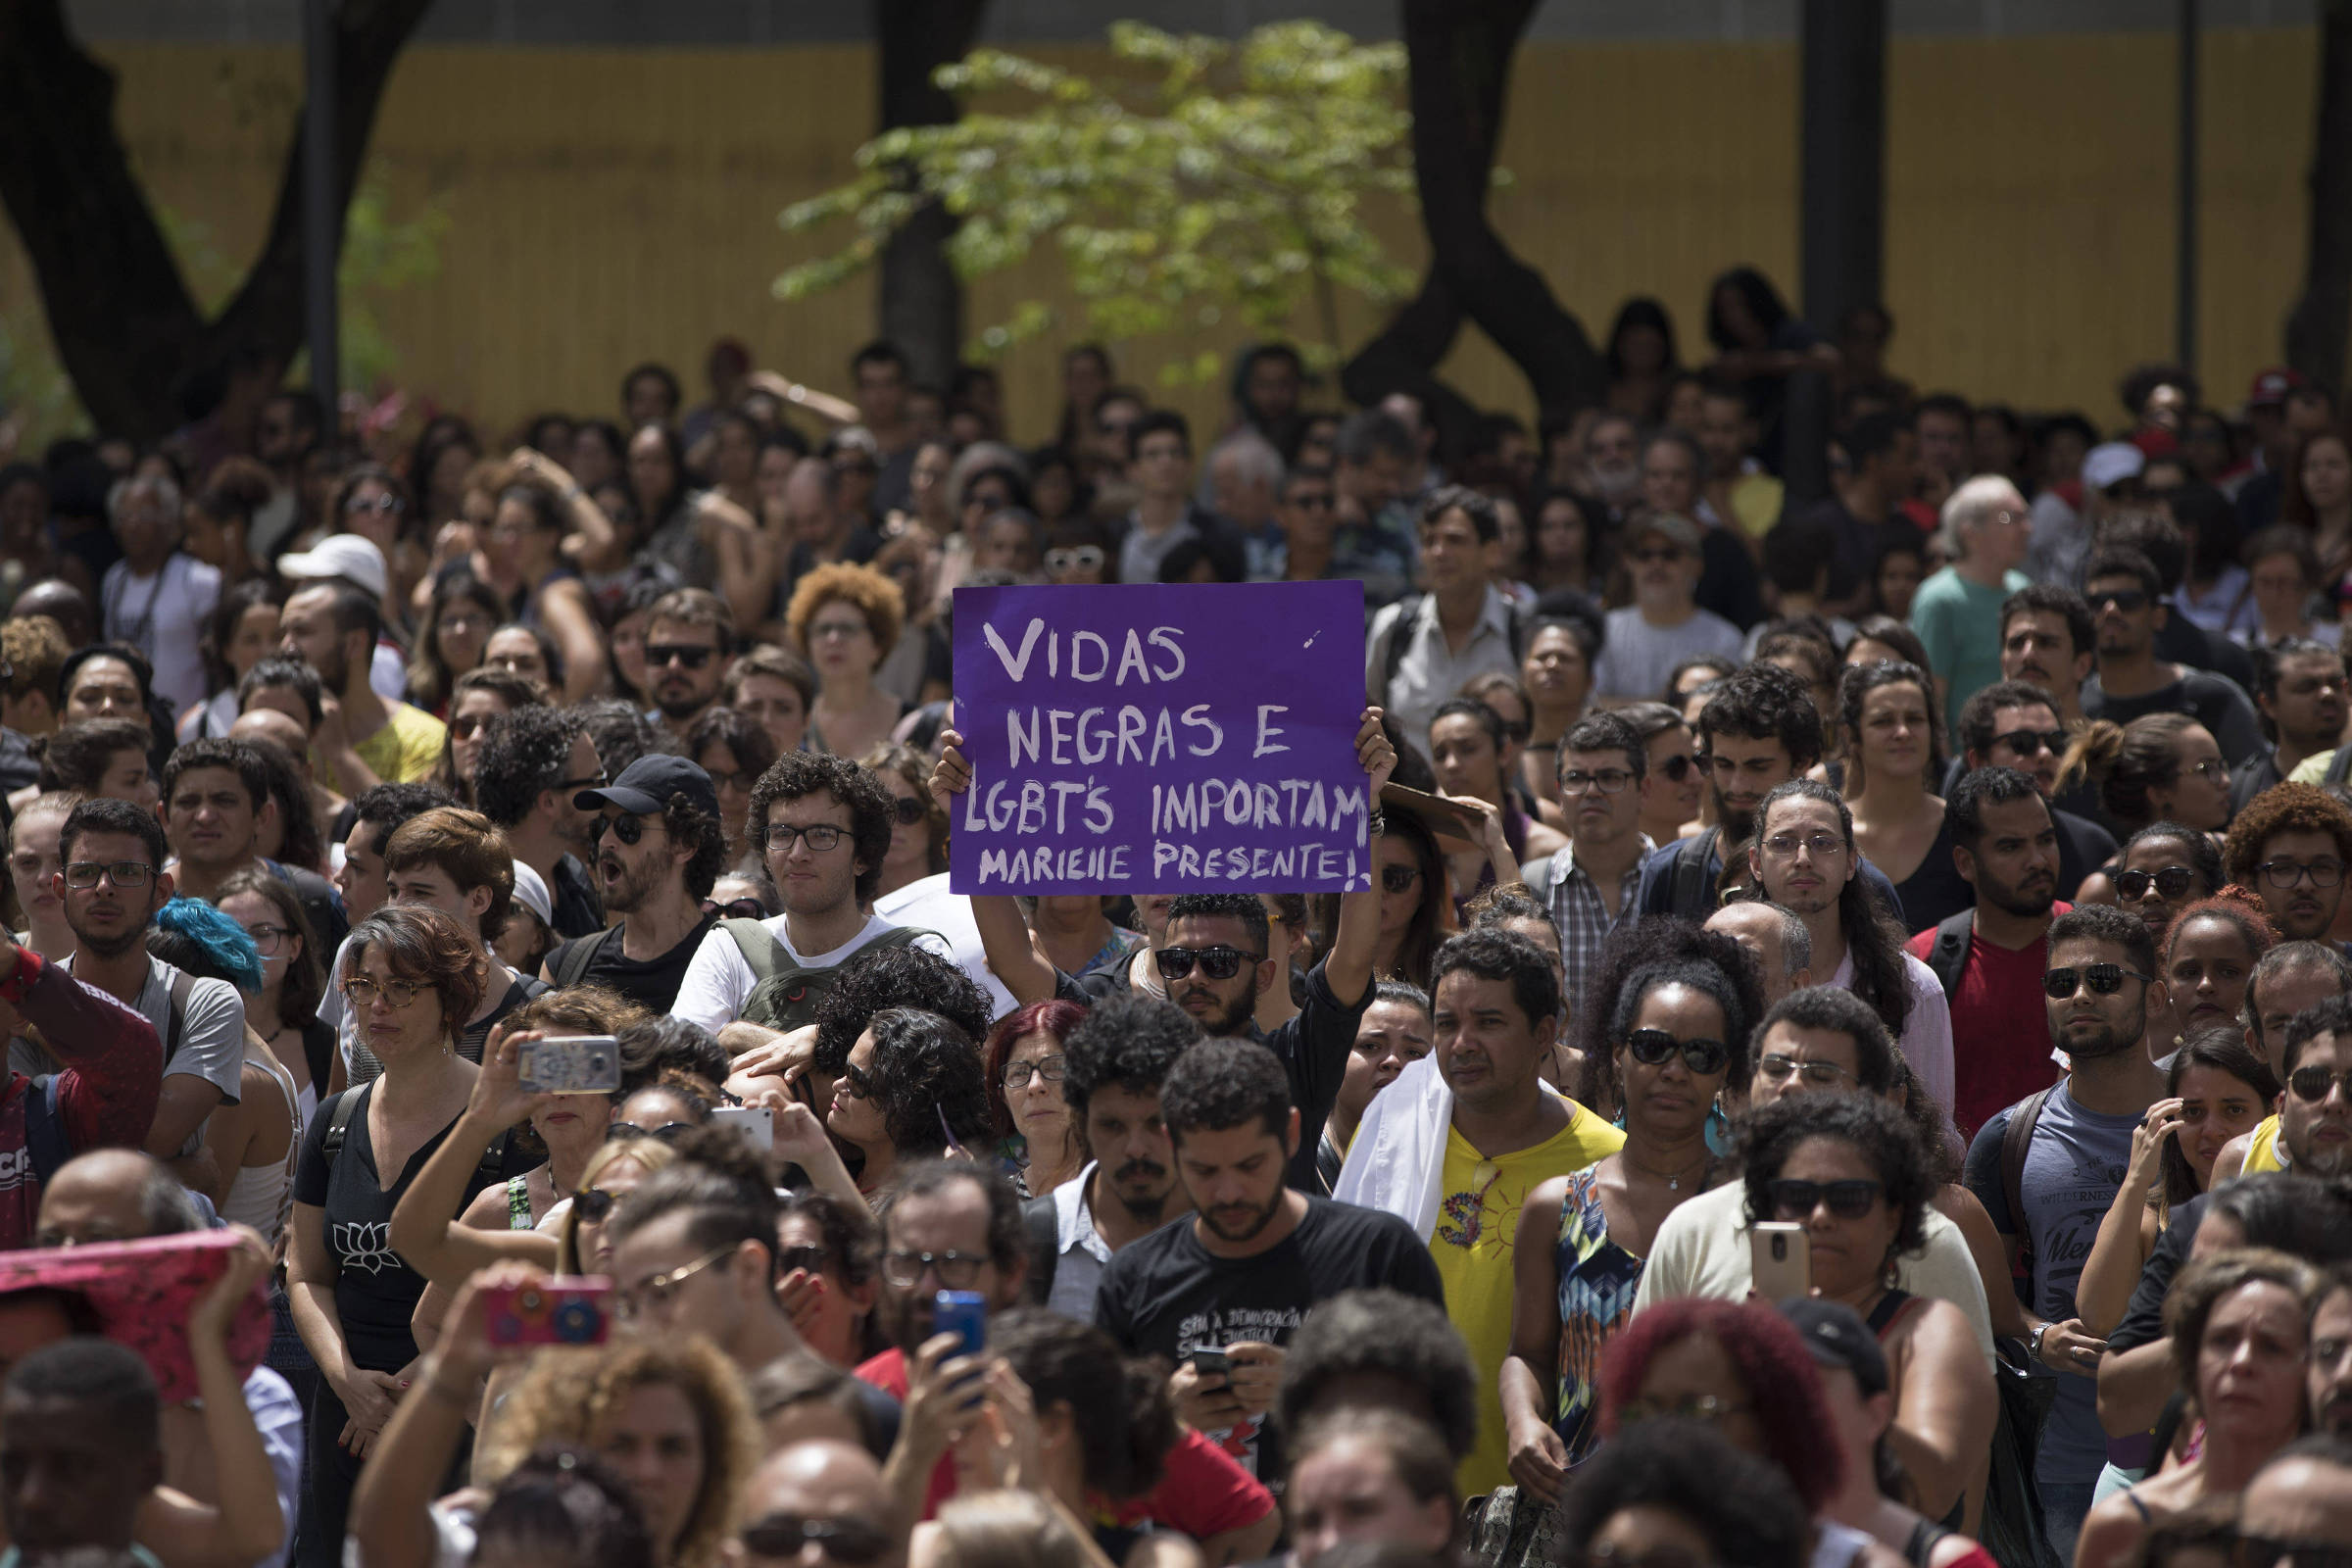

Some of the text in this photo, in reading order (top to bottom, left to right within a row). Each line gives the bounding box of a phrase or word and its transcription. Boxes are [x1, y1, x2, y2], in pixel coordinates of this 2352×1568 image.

[983, 618, 1186, 686] VIDAS
[1006, 705, 1292, 768] NEGRAS E
[964, 762, 1367, 848] LGBT'S IMPORTAM
[1153, 839, 1357, 893] PRESENTE!
